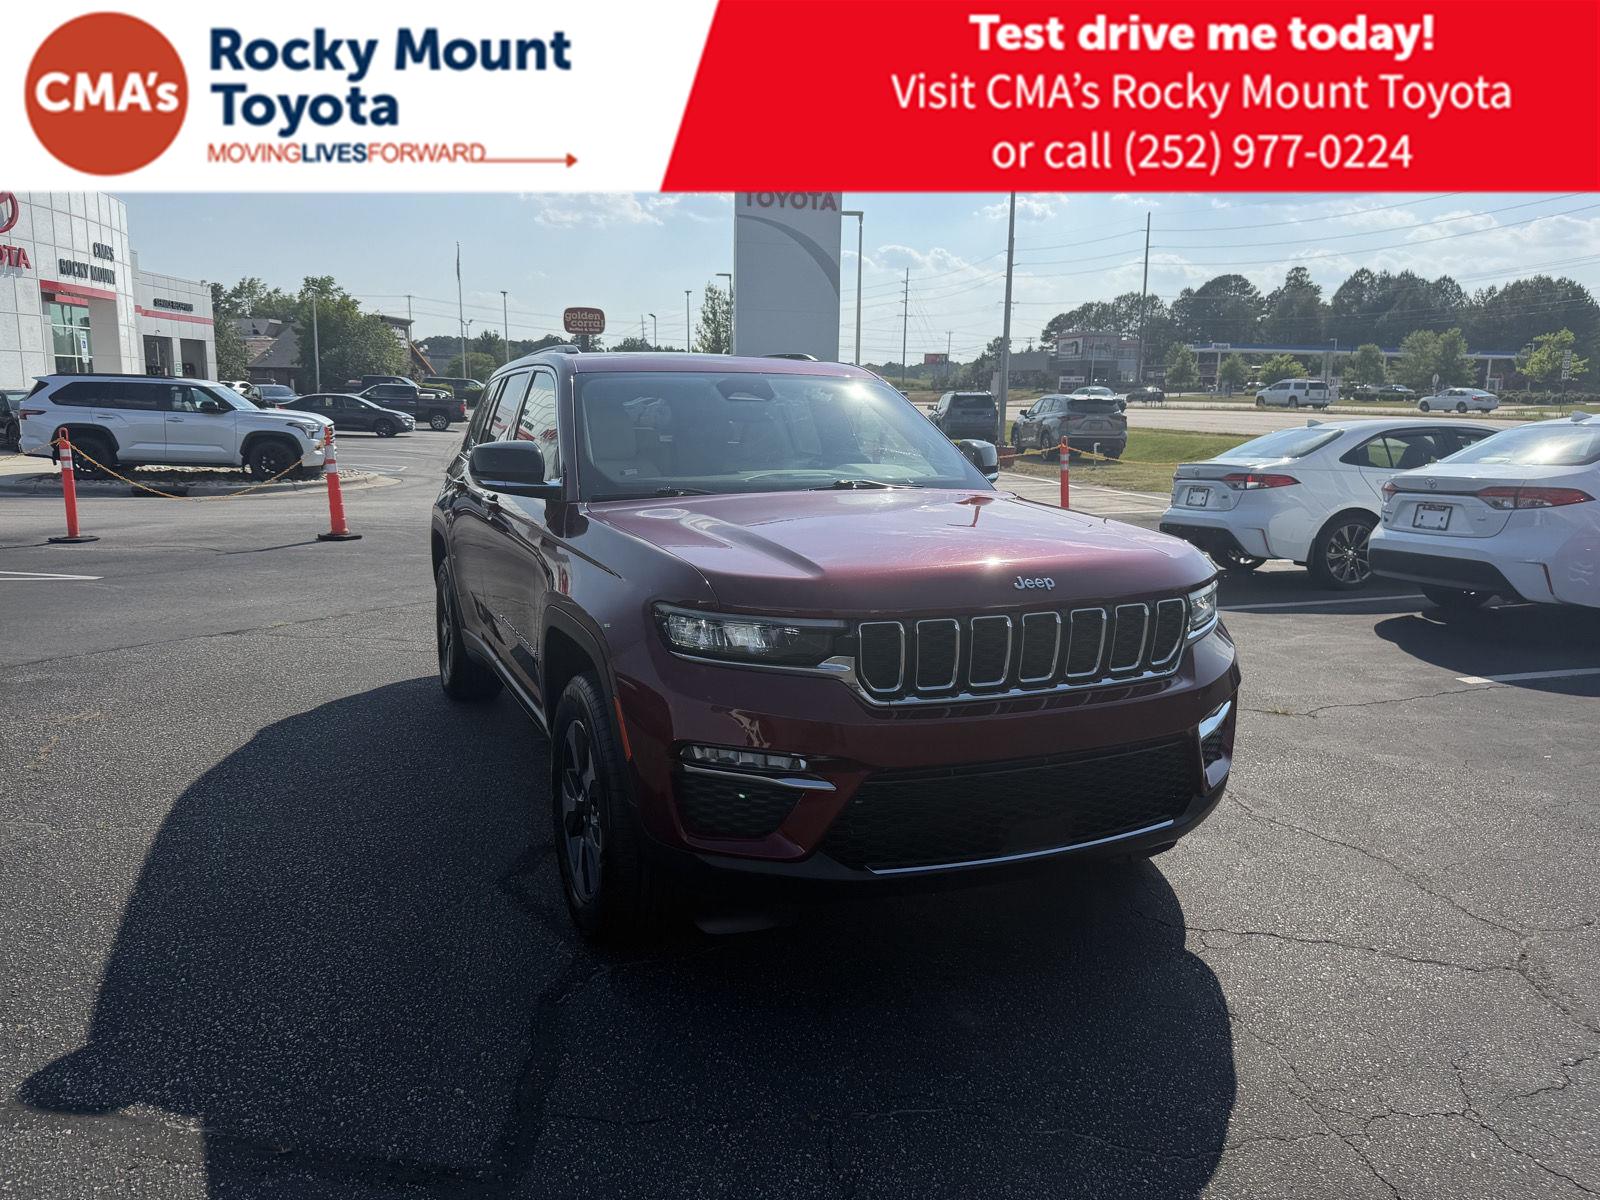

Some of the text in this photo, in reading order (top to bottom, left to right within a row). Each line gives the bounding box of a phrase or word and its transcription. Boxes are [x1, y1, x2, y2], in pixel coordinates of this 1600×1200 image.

[746, 191, 838, 211] TOYOTA
[58, 258, 115, 285] ROCKY MOUNT
[564, 311, 601, 322] golden
[570, 319, 605, 328] corral
[1013, 575, 1056, 591] Jeep
